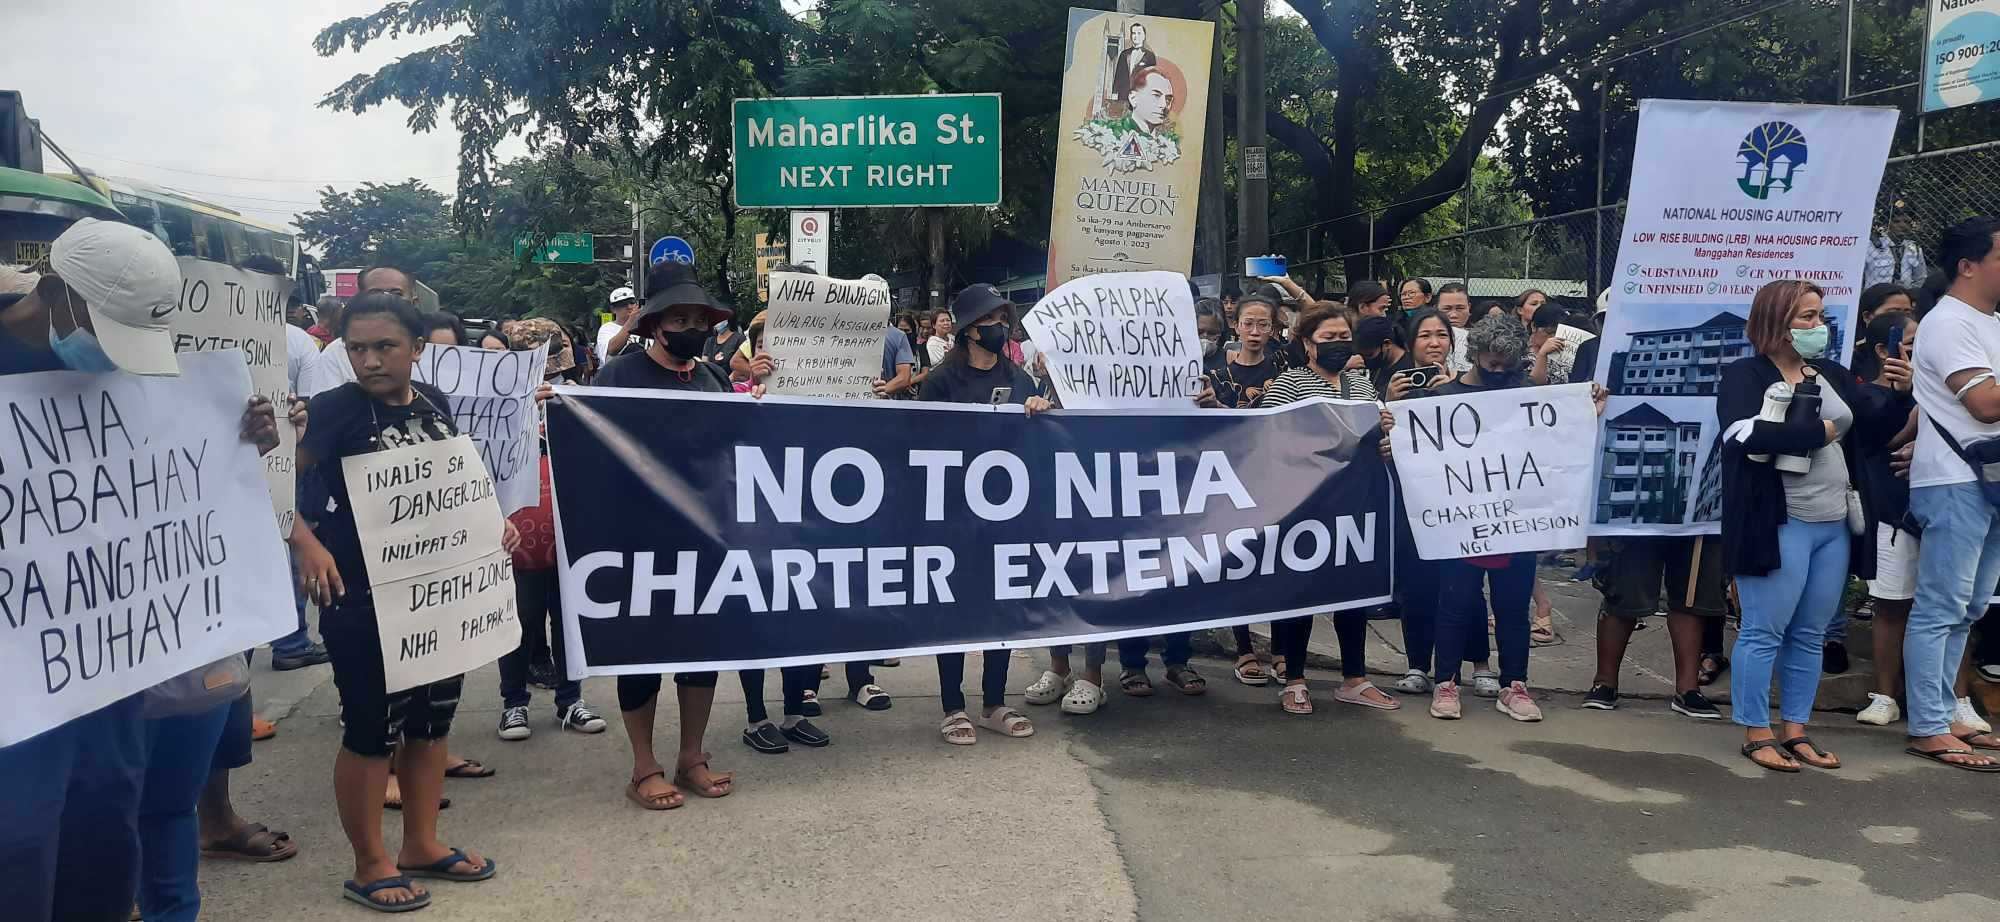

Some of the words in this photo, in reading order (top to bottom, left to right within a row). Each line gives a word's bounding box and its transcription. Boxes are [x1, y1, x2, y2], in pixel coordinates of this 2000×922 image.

[1935, 51, 1956, 65] ISO
[748, 115, 917, 148] Maharlika
[936, 113, 985, 145] St.
[780, 165, 853, 188] NEXT
[867, 164, 953, 187] RIGHT
[1080, 176, 1159, 197] MANUEL
[1167, 184, 1180, 199] L.
[1077, 192, 1176, 217] QUEZON
[1662, 207, 1717, 221] NATIONAL
[1721, 208, 1774, 221] HOUSING
[1776, 209, 1843, 223] AUTHORITY
[1076, 215, 1086, 223] Sa
[1088, 216, 1112, 226] ika-79
[1126, 219, 1171, 232] Anibersaryo
[1081, 226, 1091, 235] ng
[1093, 225, 1124, 238] kanyang
[1126, 230, 1165, 240] pagpanaw
[1094, 236, 1121, 247] Agosto
[1130, 240, 1150, 249] 2023
[1632, 232, 1656, 243] LOW
[1659, 232, 1680, 243] RISE
[1682, 233, 1724, 244] BUILDING
[1725, 233, 1751, 246] (LRB)
[1754, 234, 1776, 245] NHA
[1776, 235, 1818, 246] HOUSING
[1819, 236, 1859, 247] PROJECT
[1694, 247, 1743, 260] Manggahan
[1745, 248, 1795, 259] Residences
[1641, 267, 1719, 278] SUBSTANDARD
[1749, 268, 1765, 279] CR
[1768, 269, 1791, 279] NOT
[1794, 269, 1844, 280] WORKING
[776, 279, 816, 303] NHA
[1638, 284, 1704, 295] UNFINISHED
[1730, 284, 1754, 295] YEARS
[224, 281, 246, 317] TO
[255, 288, 284, 327] NHA
[1033, 291, 1092, 325] NHA
[1094, 287, 1175, 317] PALPAK
[773, 311, 827, 329] WALANG
[830, 311, 887, 331] KASIGURA-
[772, 335, 807, 347] DUHAN
[812, 335, 825, 346] SA
[830, 335, 880, 348] PABAHAY
[470, 349, 519, 397] TO
[773, 358, 787, 371] AT
[797, 356, 857, 370] KABUHAYAN
[777, 375, 823, 389] BAGUHIN
[825, 376, 843, 386] ANG
[1056, 363, 1101, 397] NHA
[1408, 402, 1481, 454] NO
[1519, 401, 1557, 427] TO
[447, 455, 465, 474] SA
[1444, 451, 1544, 496] NHA
[734, 446, 885, 523] NO
[909, 449, 1030, 522] TO
[1054, 450, 1257, 520] NHA
[389, 480, 469, 525] DANGER
[1422, 499, 1520, 528] CHARTER
[450, 529, 468, 547] SA
[1472, 515, 1579, 540] EXTENSION
[1459, 539, 1493, 556] NGC
[65, 537, 135, 615] ANG
[568, 545, 957, 620] CHARTER
[993, 512, 1377, 600] EXTENSION
[408, 571, 473, 612] DEATH
[478, 557, 513, 593] ZONE
[40, 584, 190, 695] BUHAY
[399, 629, 438, 662] NHA
[460, 608, 504, 642] PALPAK
